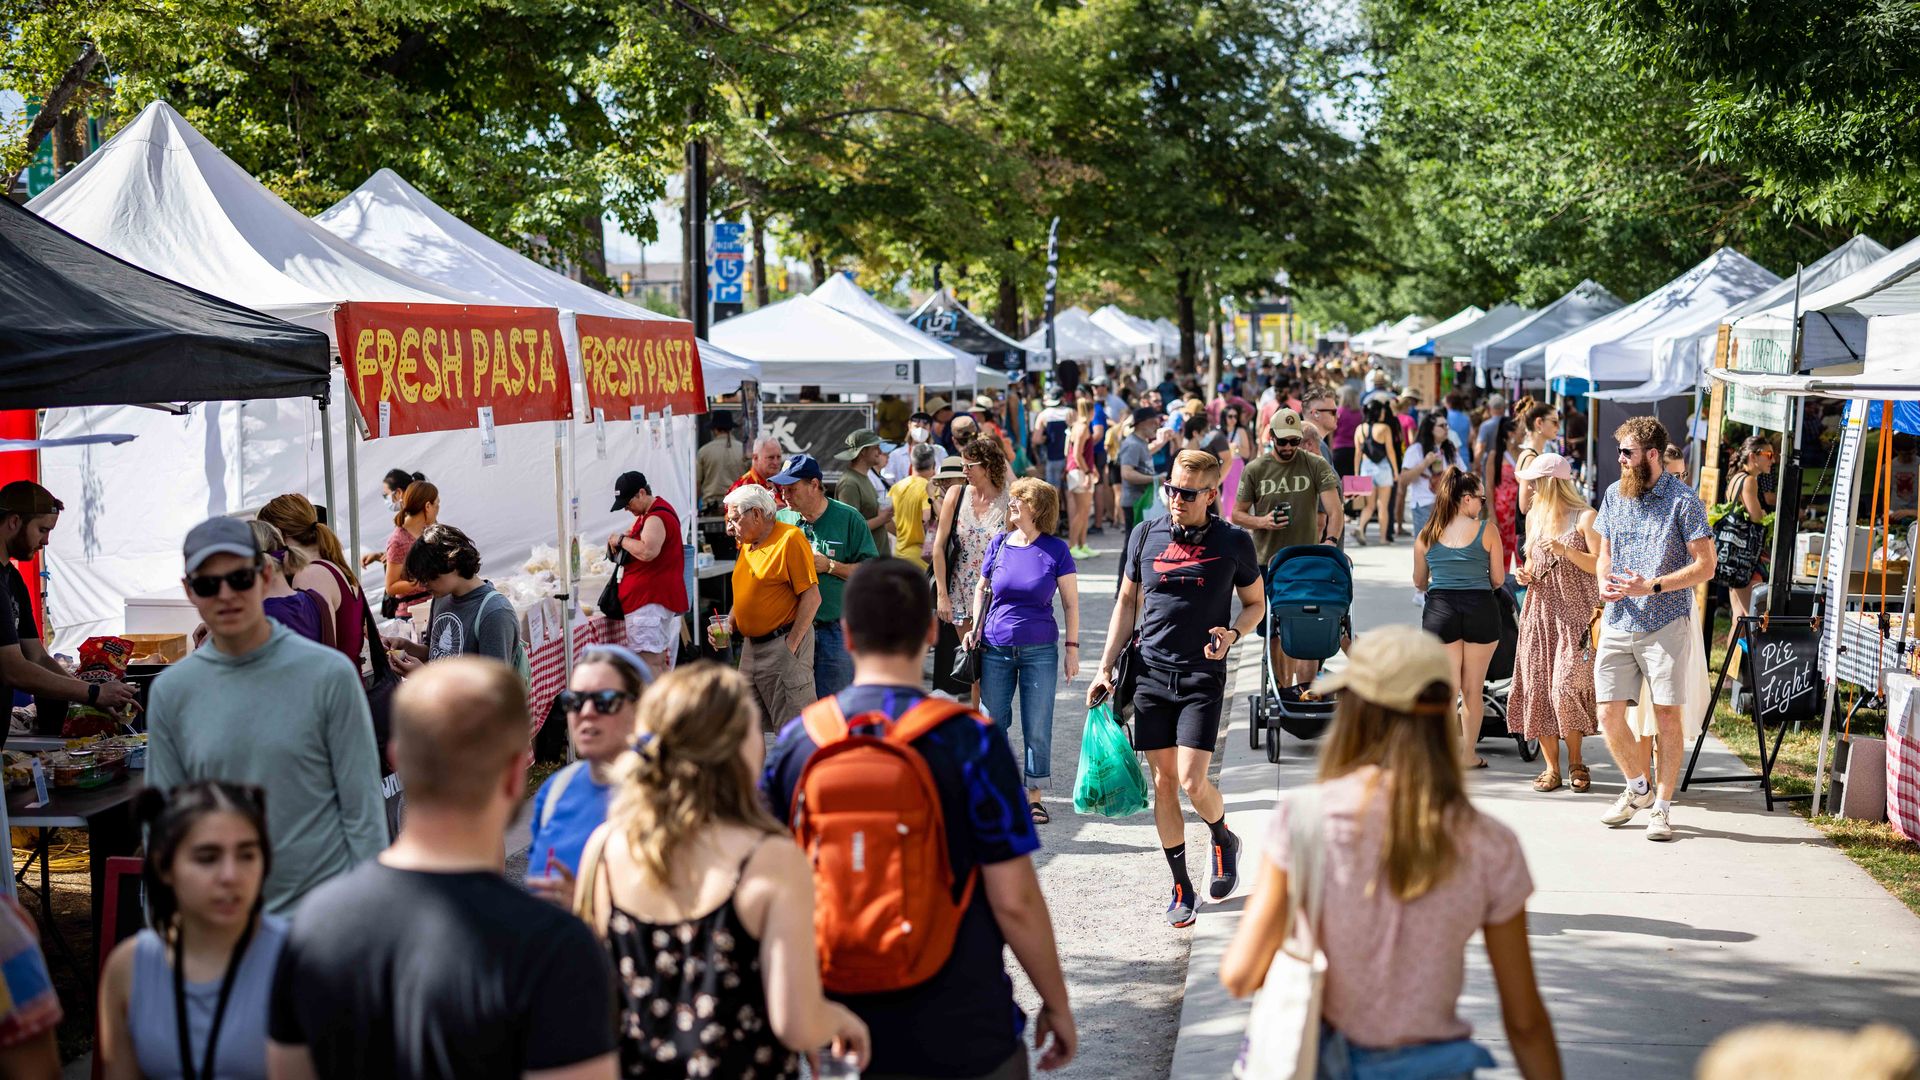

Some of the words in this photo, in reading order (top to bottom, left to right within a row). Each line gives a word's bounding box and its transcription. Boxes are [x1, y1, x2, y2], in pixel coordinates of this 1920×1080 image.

[723, 226, 739, 236] TO
[722, 260, 738, 278] 15
[356, 327, 462, 406] FRESH
[471, 327, 557, 398] PASTA
[581, 335, 644, 397] FRESH
[643, 338, 695, 394] PASTA
[1260, 475, 1311, 496] DAD
[1160, 543, 1206, 560] NIKE
[1159, 574, 1204, 587] AIR
